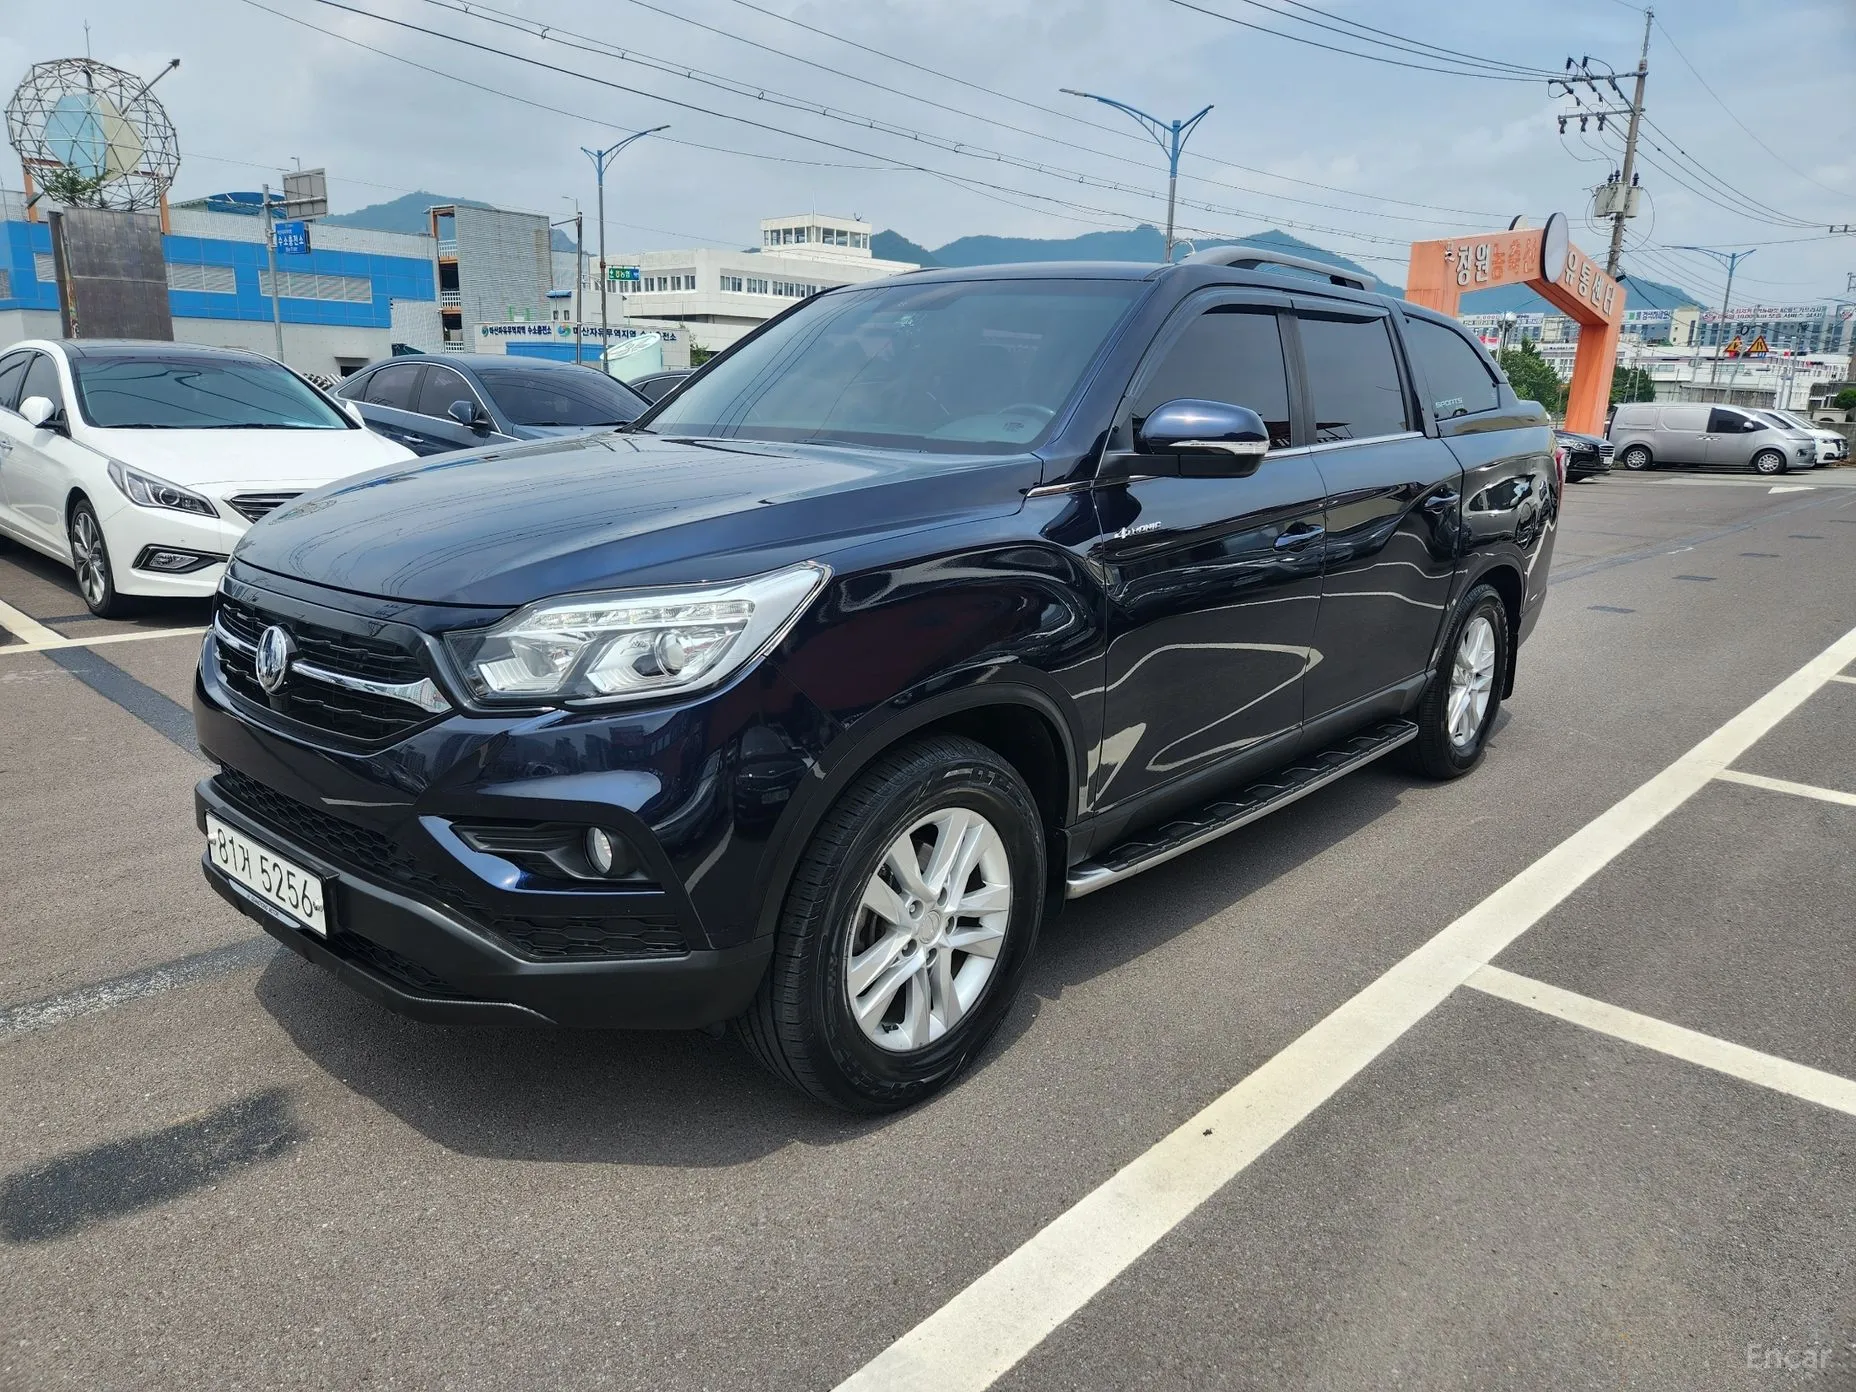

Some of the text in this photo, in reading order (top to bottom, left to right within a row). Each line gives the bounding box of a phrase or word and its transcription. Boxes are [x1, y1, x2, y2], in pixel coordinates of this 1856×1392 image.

[1565, 251, 1615, 317] 유통센터
[528, 325, 552, 335] 수소충전소
[1435, 397, 1463, 409] SPORTS
[260, 855, 313, 918] 5256
